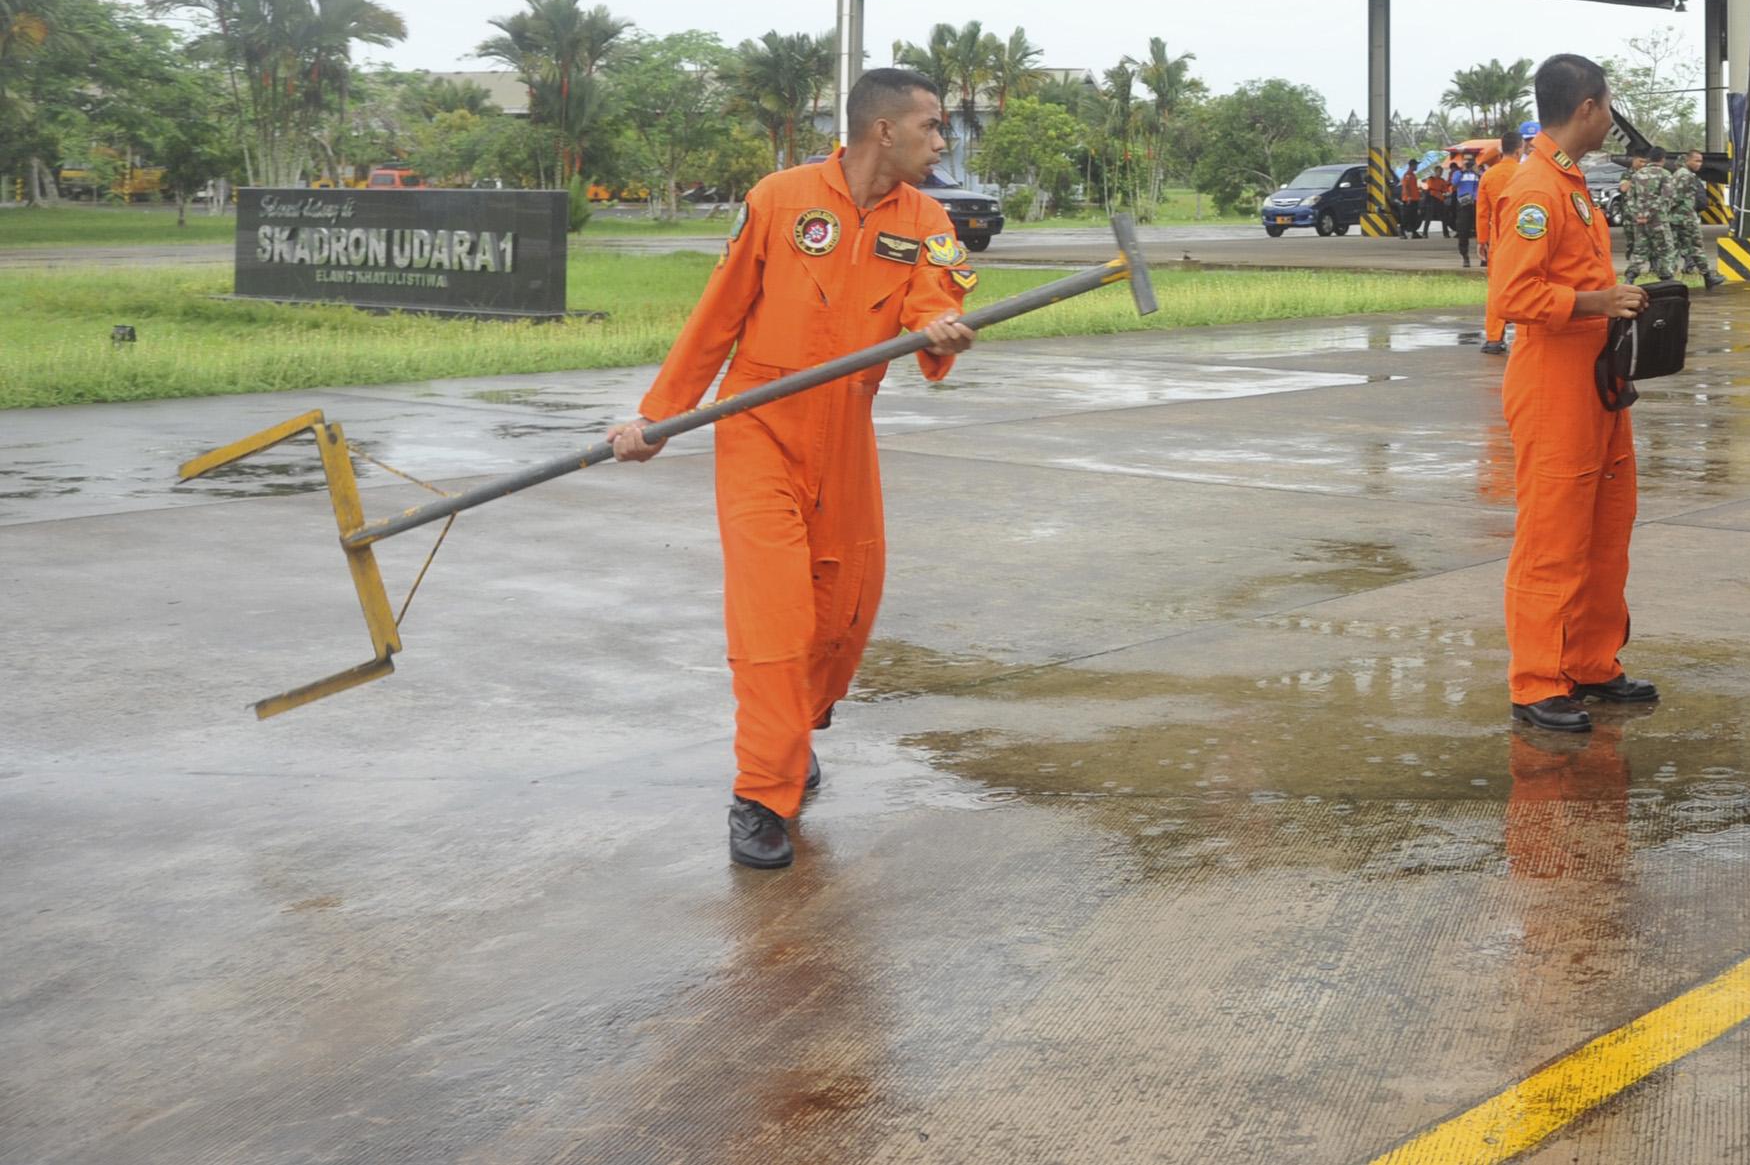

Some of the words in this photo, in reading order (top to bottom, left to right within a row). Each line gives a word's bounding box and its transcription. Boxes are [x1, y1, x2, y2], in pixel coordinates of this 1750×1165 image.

[256, 225, 387, 267] SKADRON
[392, 229, 497, 273] UDARA
[499, 232, 514, 273] 1
[315, 270, 353, 283] ELANG
[355, 271, 448, 288] KHATULISTIWA
